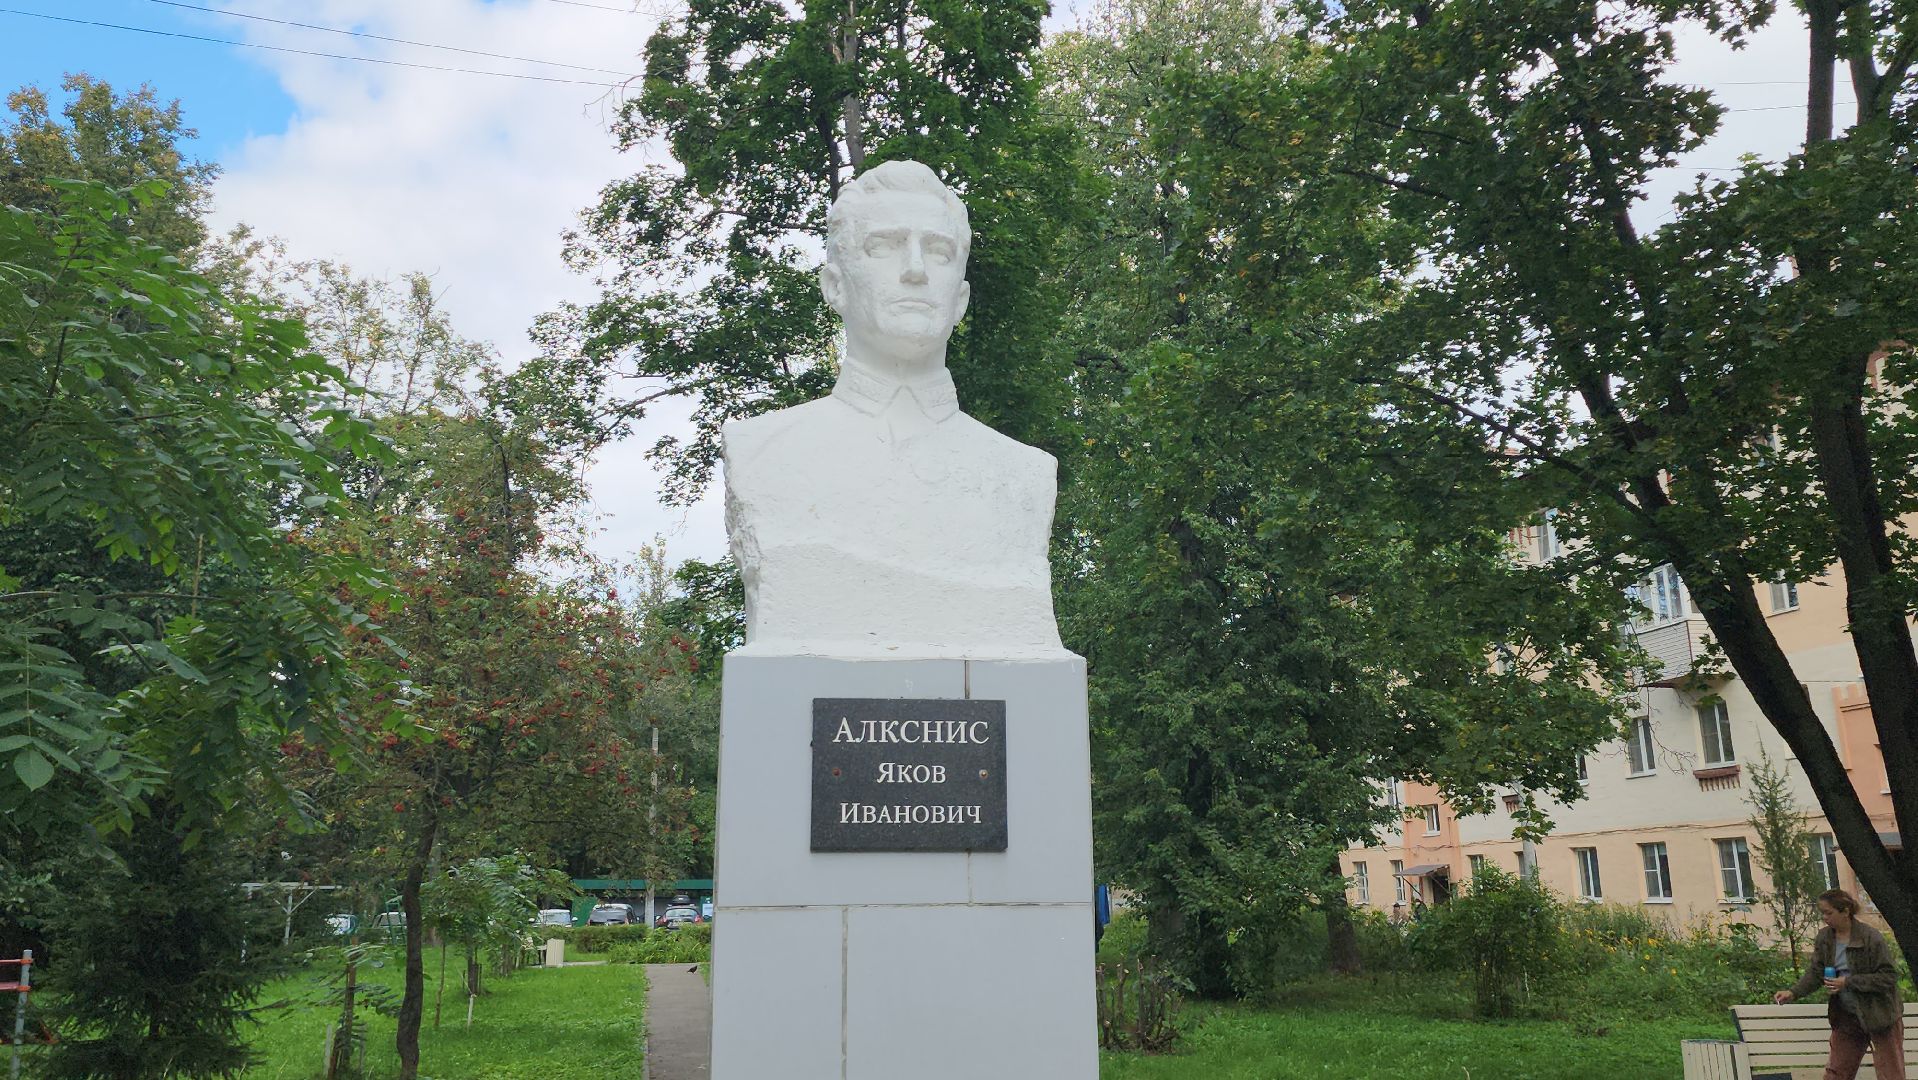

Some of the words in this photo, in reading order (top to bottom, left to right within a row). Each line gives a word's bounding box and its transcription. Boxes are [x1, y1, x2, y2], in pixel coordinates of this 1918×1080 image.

[832, 716, 990, 744] АЛКСНИС
[876, 762, 946, 784] ЯКОВ
[839, 802, 982, 824] ИВАНОВИЧ
